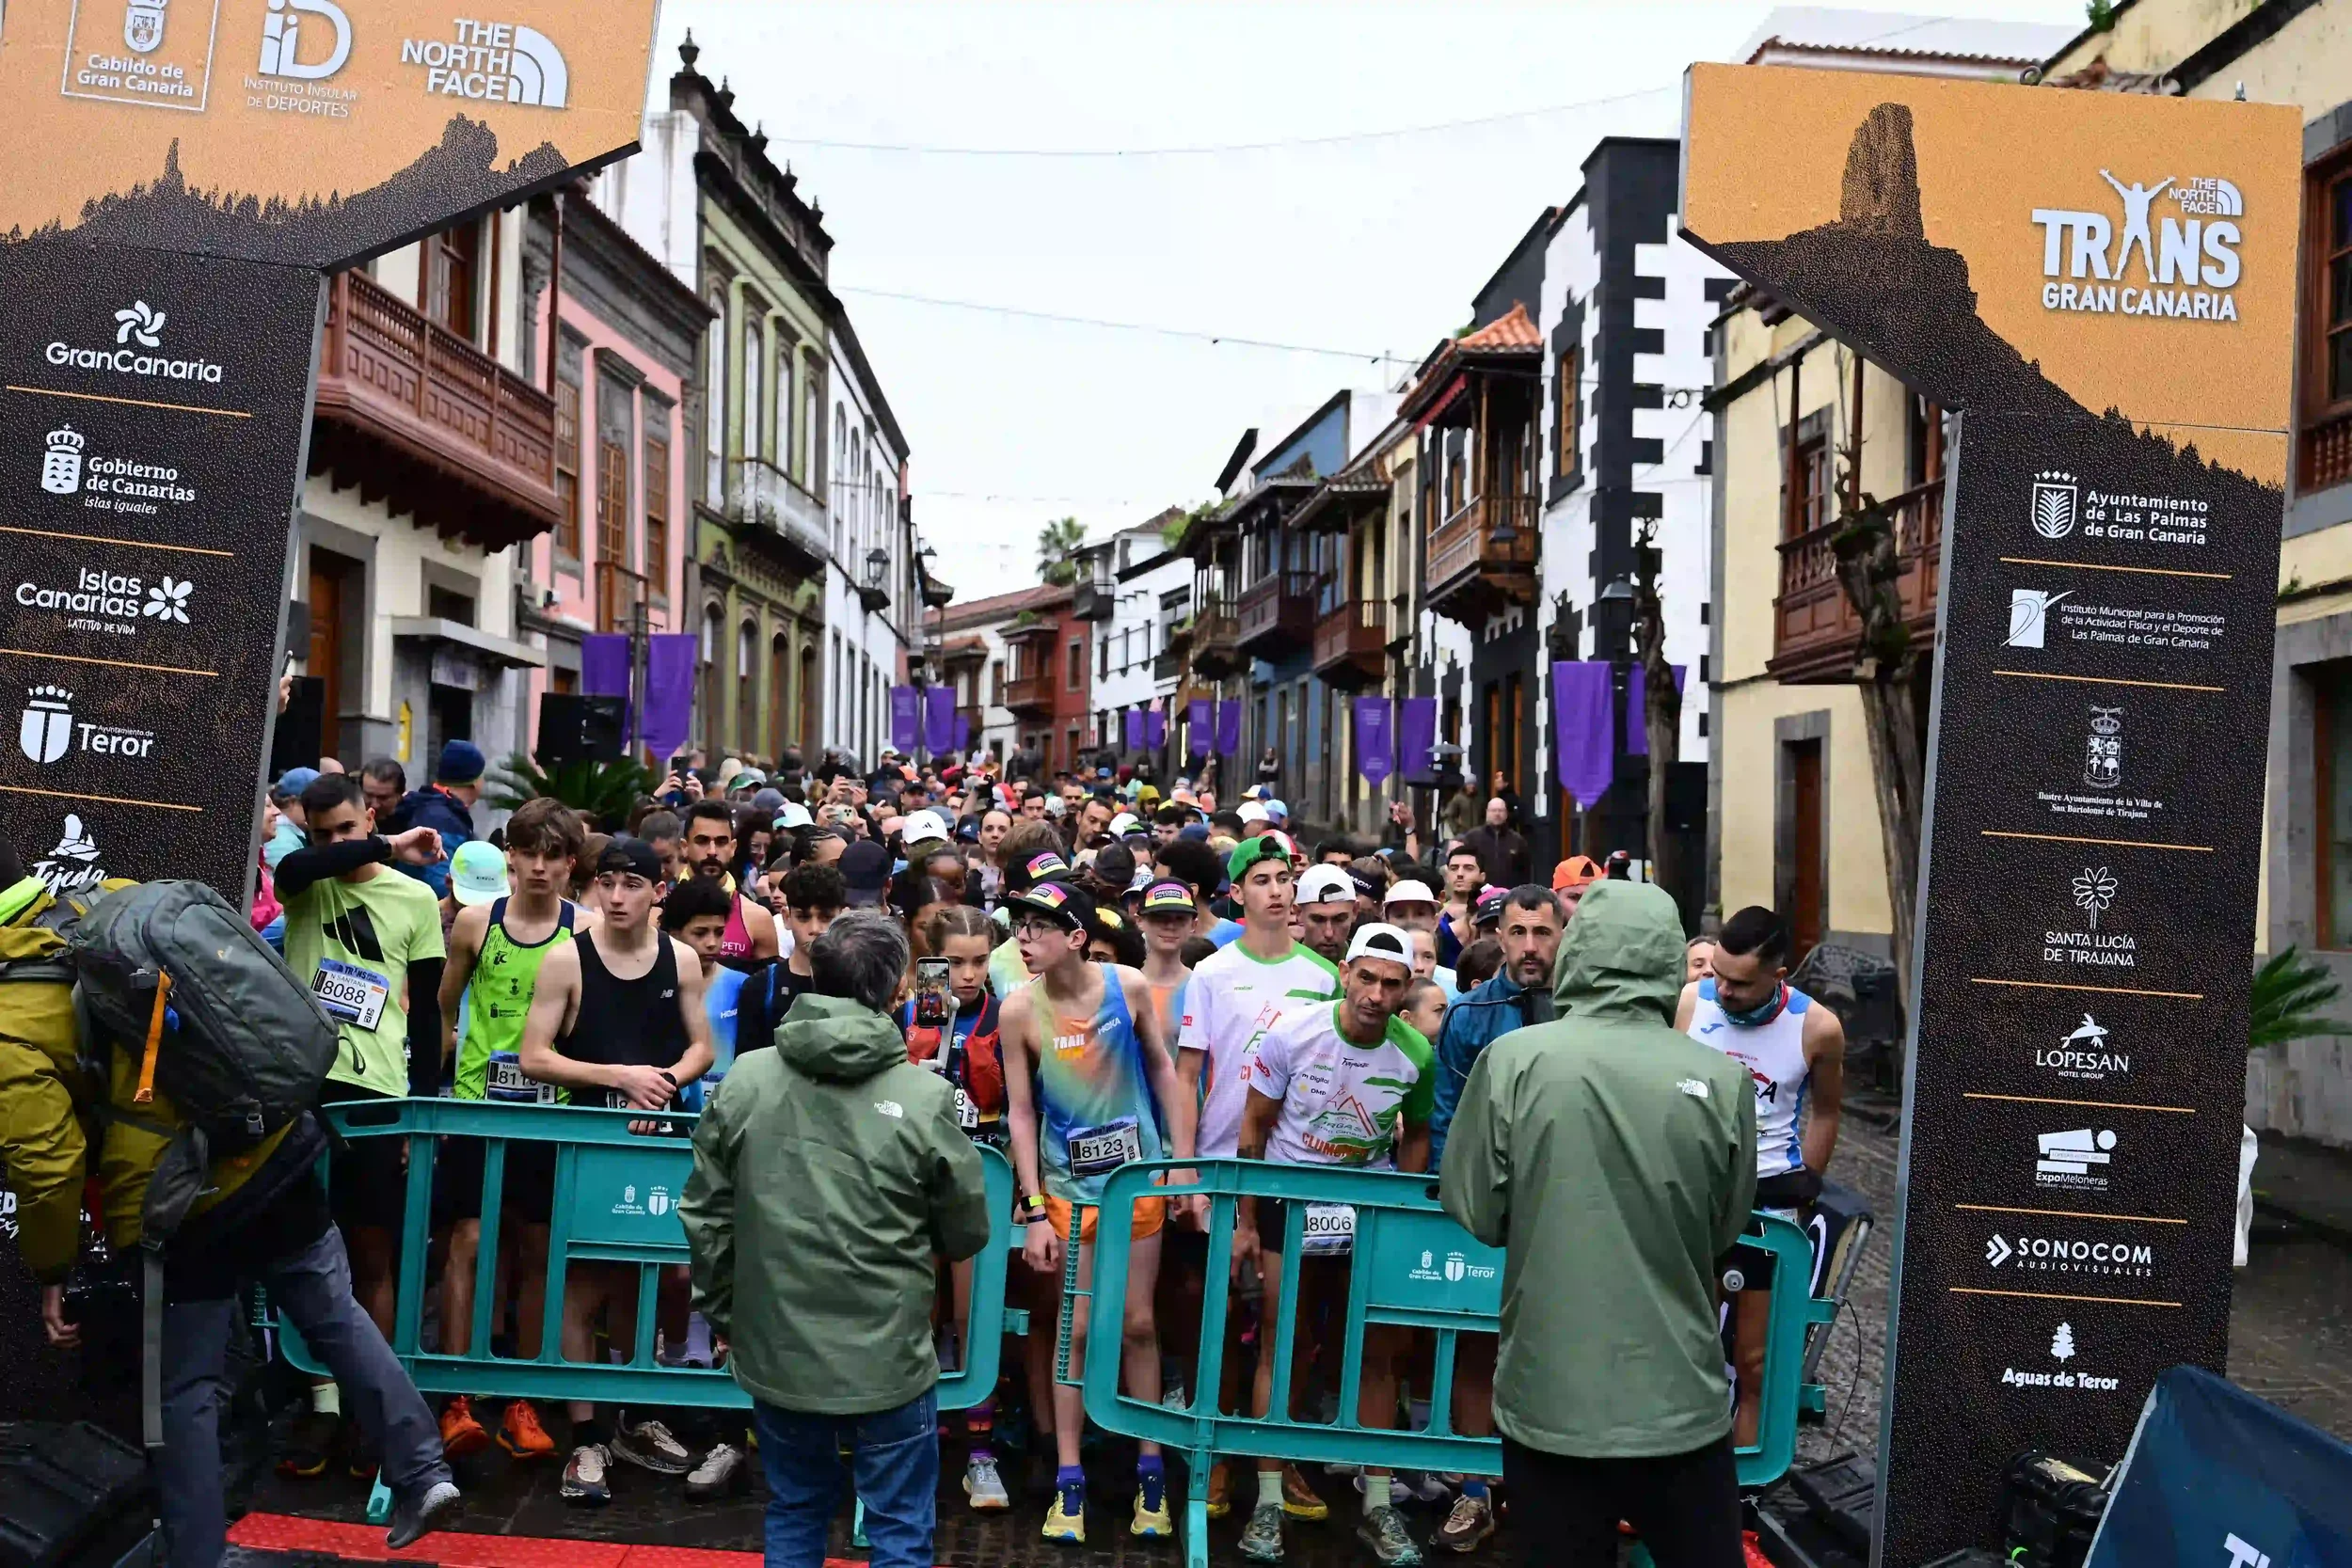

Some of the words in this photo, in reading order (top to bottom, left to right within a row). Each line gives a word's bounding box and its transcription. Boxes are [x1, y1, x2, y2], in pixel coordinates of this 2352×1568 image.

[453, 18, 513, 48] THE
[87, 54, 156, 75] Cabildo
[161, 63, 183, 79] de
[401, 39, 509, 74] NORTH
[77, 70, 120, 88] Gran
[125, 74, 193, 97] Canaria
[427, 68, 506, 101] FACE
[266, 94, 349, 118] DEPORTES
[2169, 187, 2217, 202] NORTH
[2191, 177, 2217, 191] THE
[2181, 200, 2217, 214] FACE
[2042, 282, 2115, 312] GRAN
[2121, 288, 2237, 322] CANARIA
[46, 341, 222, 383] GranCanaria
[88, 456, 178, 481] Gobierno
[86, 474, 109, 491] de
[112, 478, 195, 501] Canarias
[85, 496, 112, 509] islas
[114, 499, 158, 515] iguales
[2087, 490, 2208, 513] Ayuntamiento
[2086, 506, 2105, 521] de
[2116, 509, 2140, 524] Las
[2150, 513, 2207, 529] Palmas
[2085, 523, 2104, 537] de
[2107, 525, 2143, 540] Gran
[2149, 528, 2206, 545] Canaria
[78, 567, 141, 595] Islas
[16, 582, 139, 617] Canarias
[2060, 603, 2097, 615] Instituto
[2099, 607, 2142, 619] Municipal
[2144, 610, 2165, 621] para
[2167, 611, 2175, 621] la
[2177, 612, 2225, 625] Promoción
[67, 618, 102, 631] LATITUD
[103, 623, 115, 633] DE
[117, 624, 135, 636] VIDA
[2061, 615, 2073, 625] de
[2075, 616, 2083, 626] la
[2085, 616, 2126, 629] Actividad
[2153, 624, 2160, 633] y
[2162, 623, 2170, 631] el
[2172, 624, 2209, 637] Deporte
[2211, 626, 2223, 636] de
[2072, 629, 2087, 641] Las
[2090, 631, 2125, 643] Palmas
[2128, 633, 2141, 644] de
[2143, 635, 2169, 647] Gran
[2171, 637, 2209, 649] Canaria
[78, 723, 153, 757] Teror
[2051, 803, 2066, 812] San
[2106, 807, 2115, 816] de
[2117, 808, 2148, 819] Tirajana
[2063, 794, 2114, 805] Ayuntamiento
[2115, 798, 2124, 806] de
[2126, 799, 2133, 807] la
[2134, 797, 2152, 808] Villa
[2153, 800, 2163, 809] de
[32, 861, 108, 897] Tejeda
[2045, 931, 2091, 946] SANTA
[2095, 932, 2136, 949] LUCÍA
[2044, 947, 2063, 962] DE
[2068, 949, 2135, 967] TIRAJANA
[323, 980, 366, 1005] 8088
[1097, 1017, 1121, 1035] HOKA
[1053, 1034, 1085, 1051] TRAIL
[2036, 1049, 2129, 1072] LOPESAN
[1082, 1139, 1123, 1159] 8123
[2036, 1172, 2108, 1185] ExpoMeloneras
[1309, 1216, 1352, 1231] 8006
[2017, 1237, 2152, 1265] SONOCOM
[1467, 1265, 1495, 1278] Teror
[2017, 1260, 2153, 1276] AUDIOVISUALES
[2001, 1368, 2052, 1388] Aguas
[2053, 1369, 2075, 1388] de
[2077, 1371, 2119, 1391] Teror
